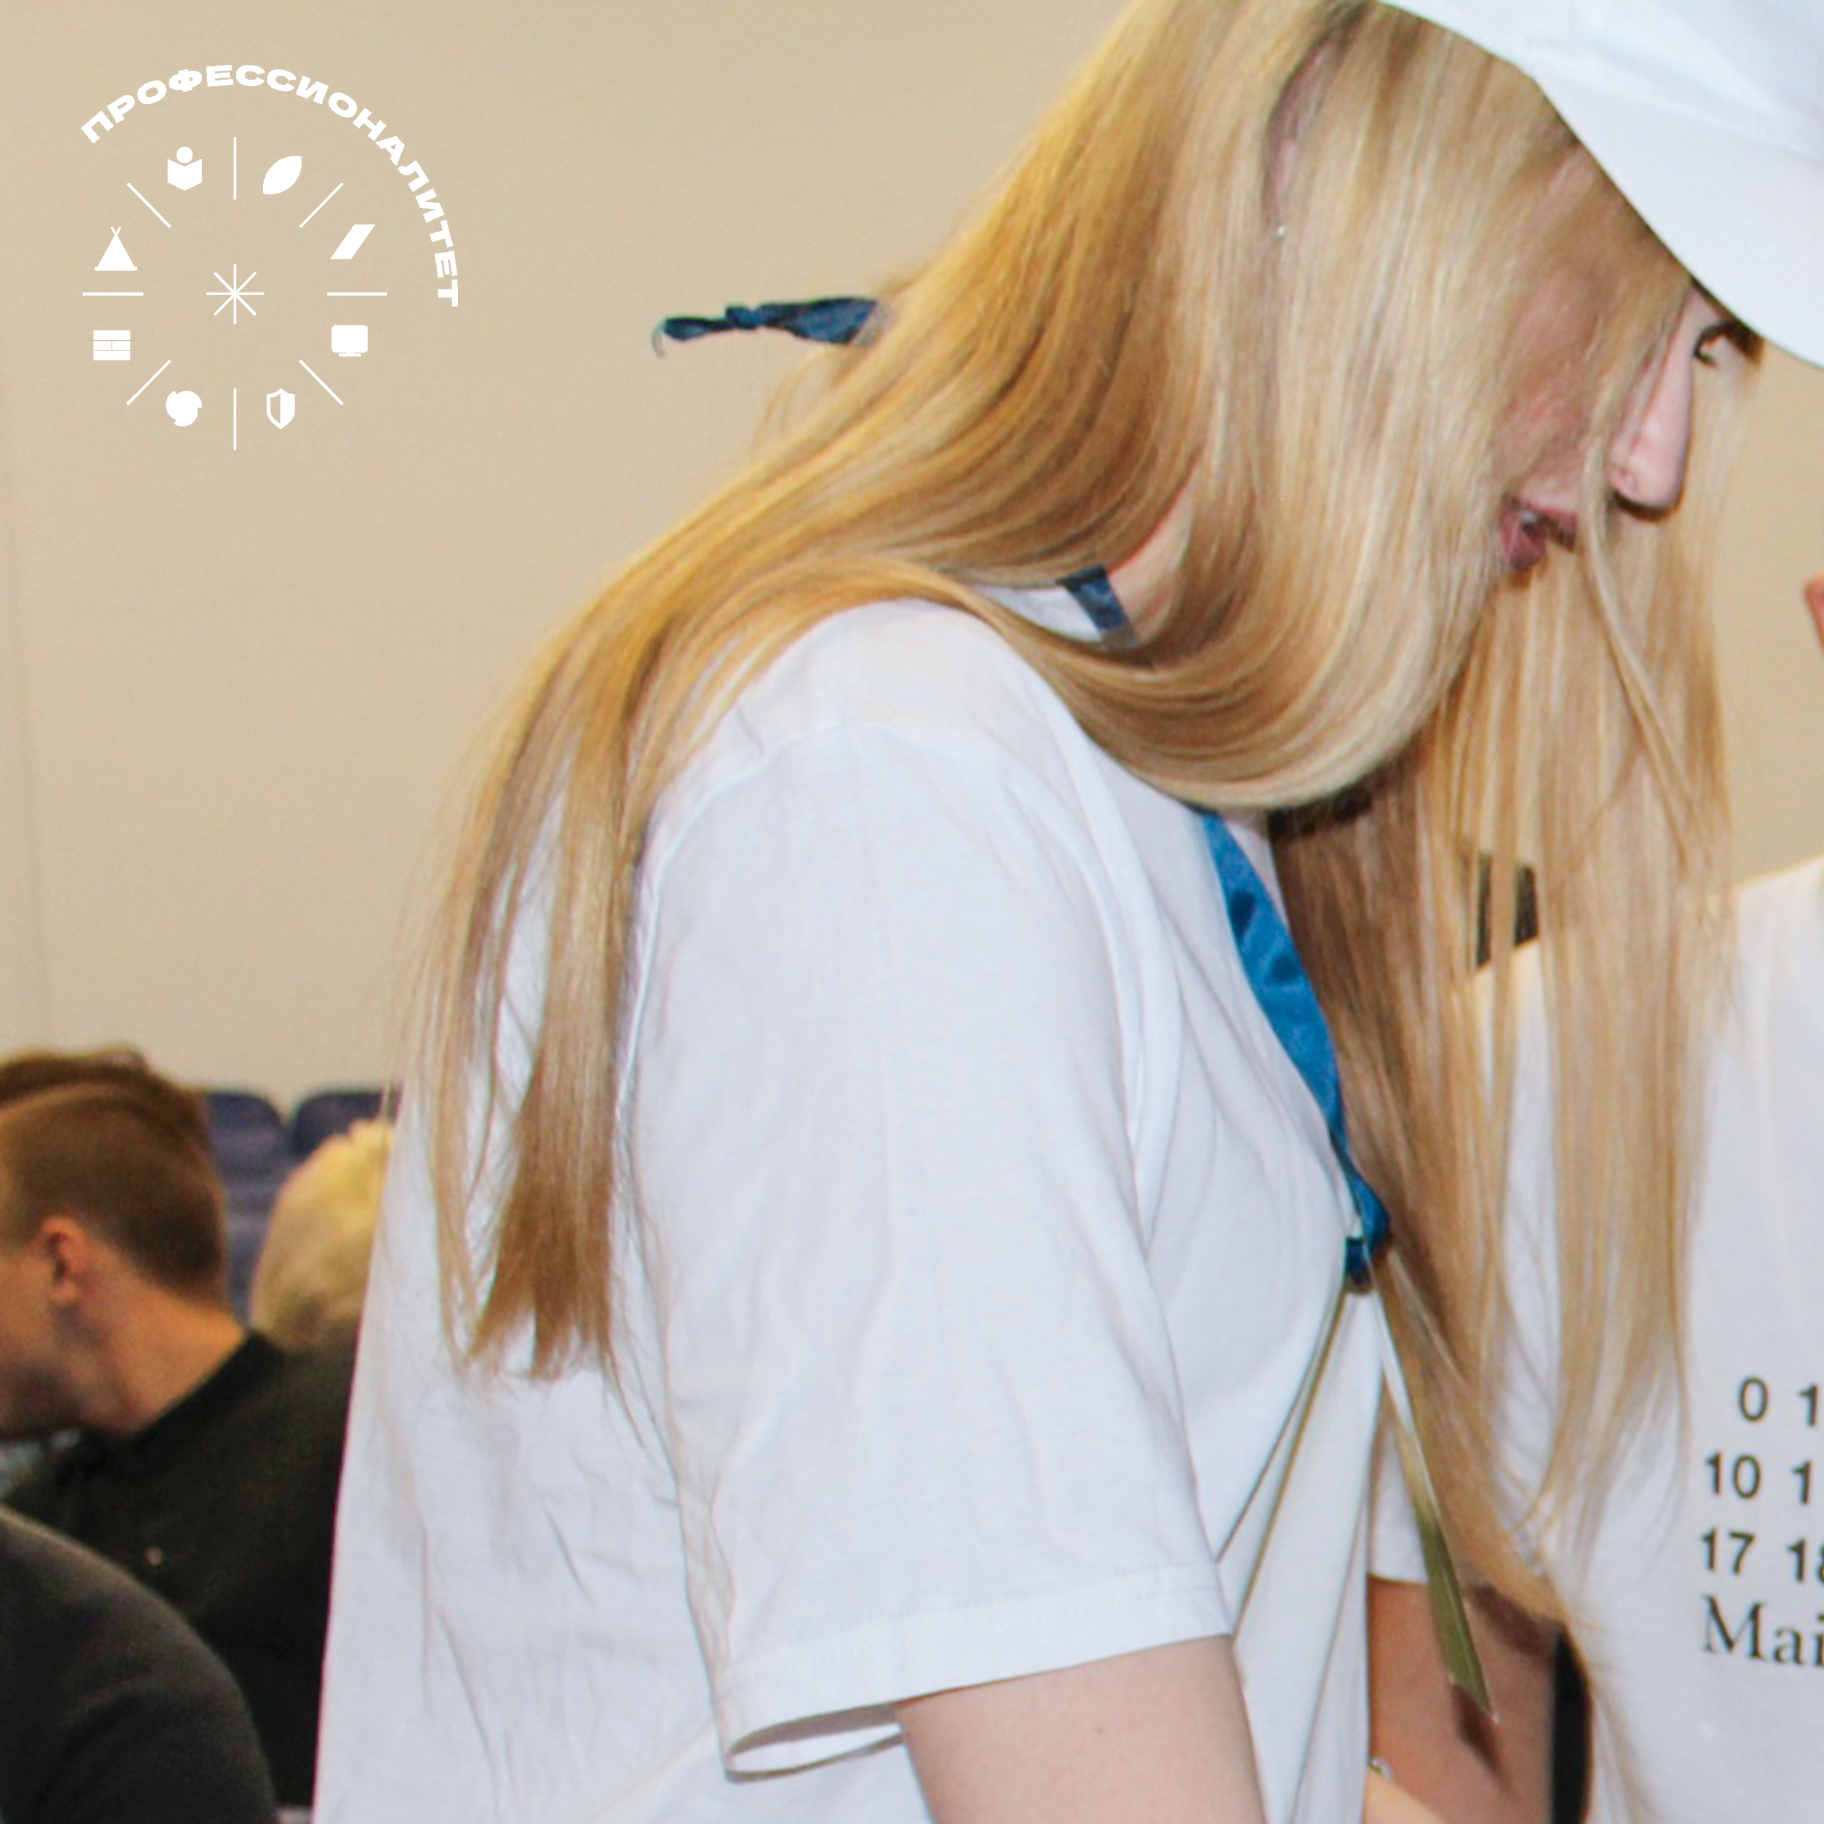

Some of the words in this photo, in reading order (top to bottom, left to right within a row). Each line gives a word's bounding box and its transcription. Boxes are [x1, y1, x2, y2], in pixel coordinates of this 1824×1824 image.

[1738, 1376, 1769, 1423] 0
[1798, 1384, 1818, 1427] 1
[1705, 1451, 1761, 1499] 10
[1701, 1528, 1757, 1575] 17
